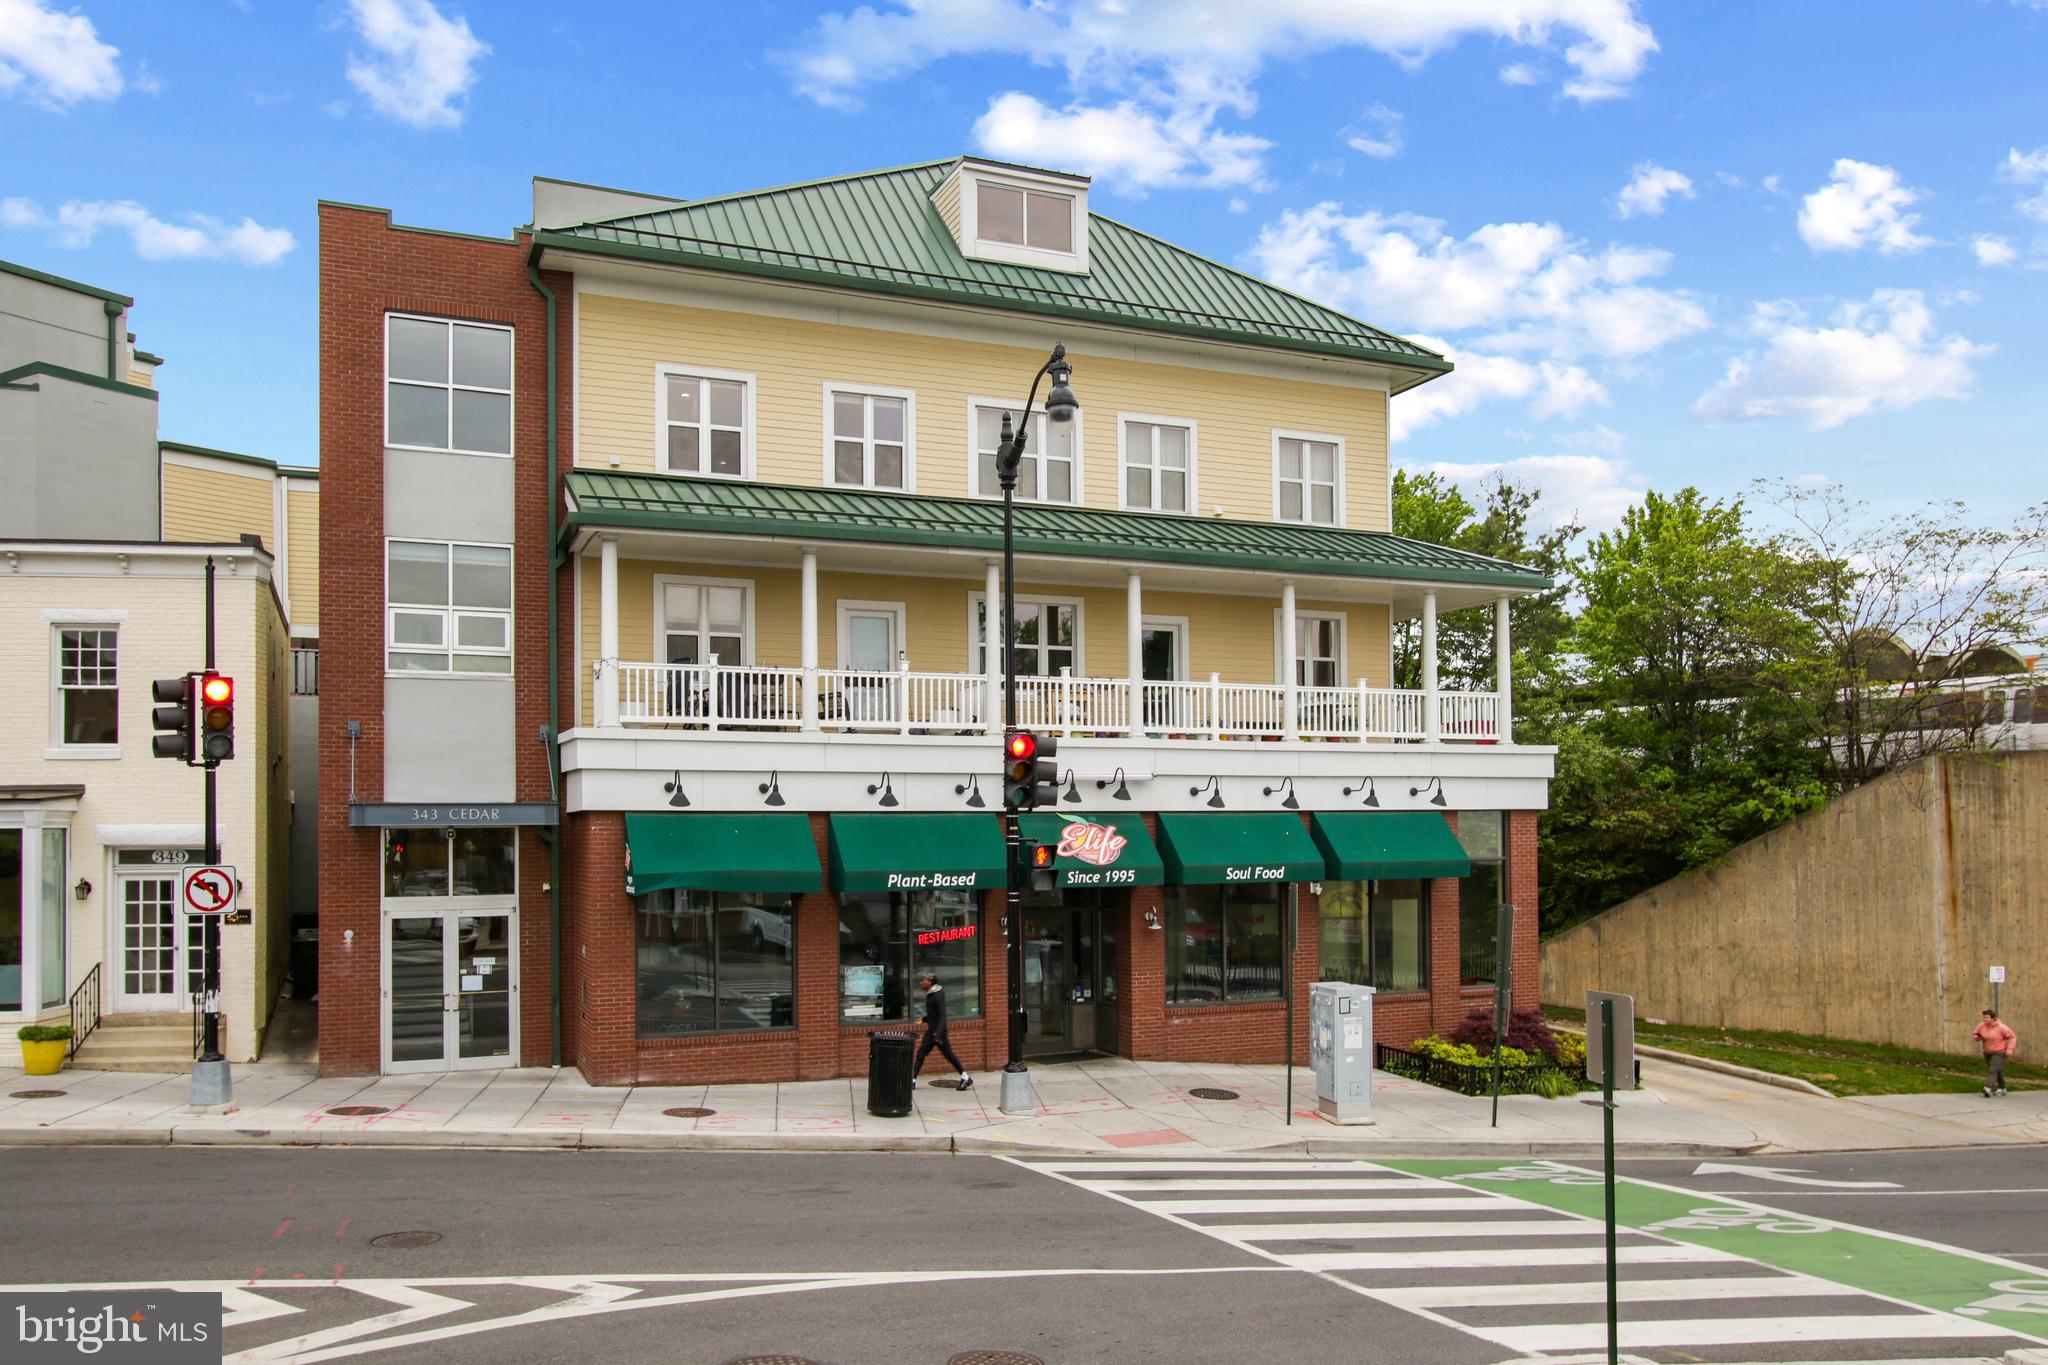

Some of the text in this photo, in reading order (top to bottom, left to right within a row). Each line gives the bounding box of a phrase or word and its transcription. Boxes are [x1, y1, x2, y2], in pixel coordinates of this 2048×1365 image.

[412, 808, 500, 820] 343 CEDAR
[1057, 823, 1127, 865] Elife
[887, 872, 976, 888] Plant-Based
[1067, 870, 1135, 883] Since 1995
[1226, 866, 1285, 880] Soul Food
[917, 925, 976, 945] RESTAURANT
